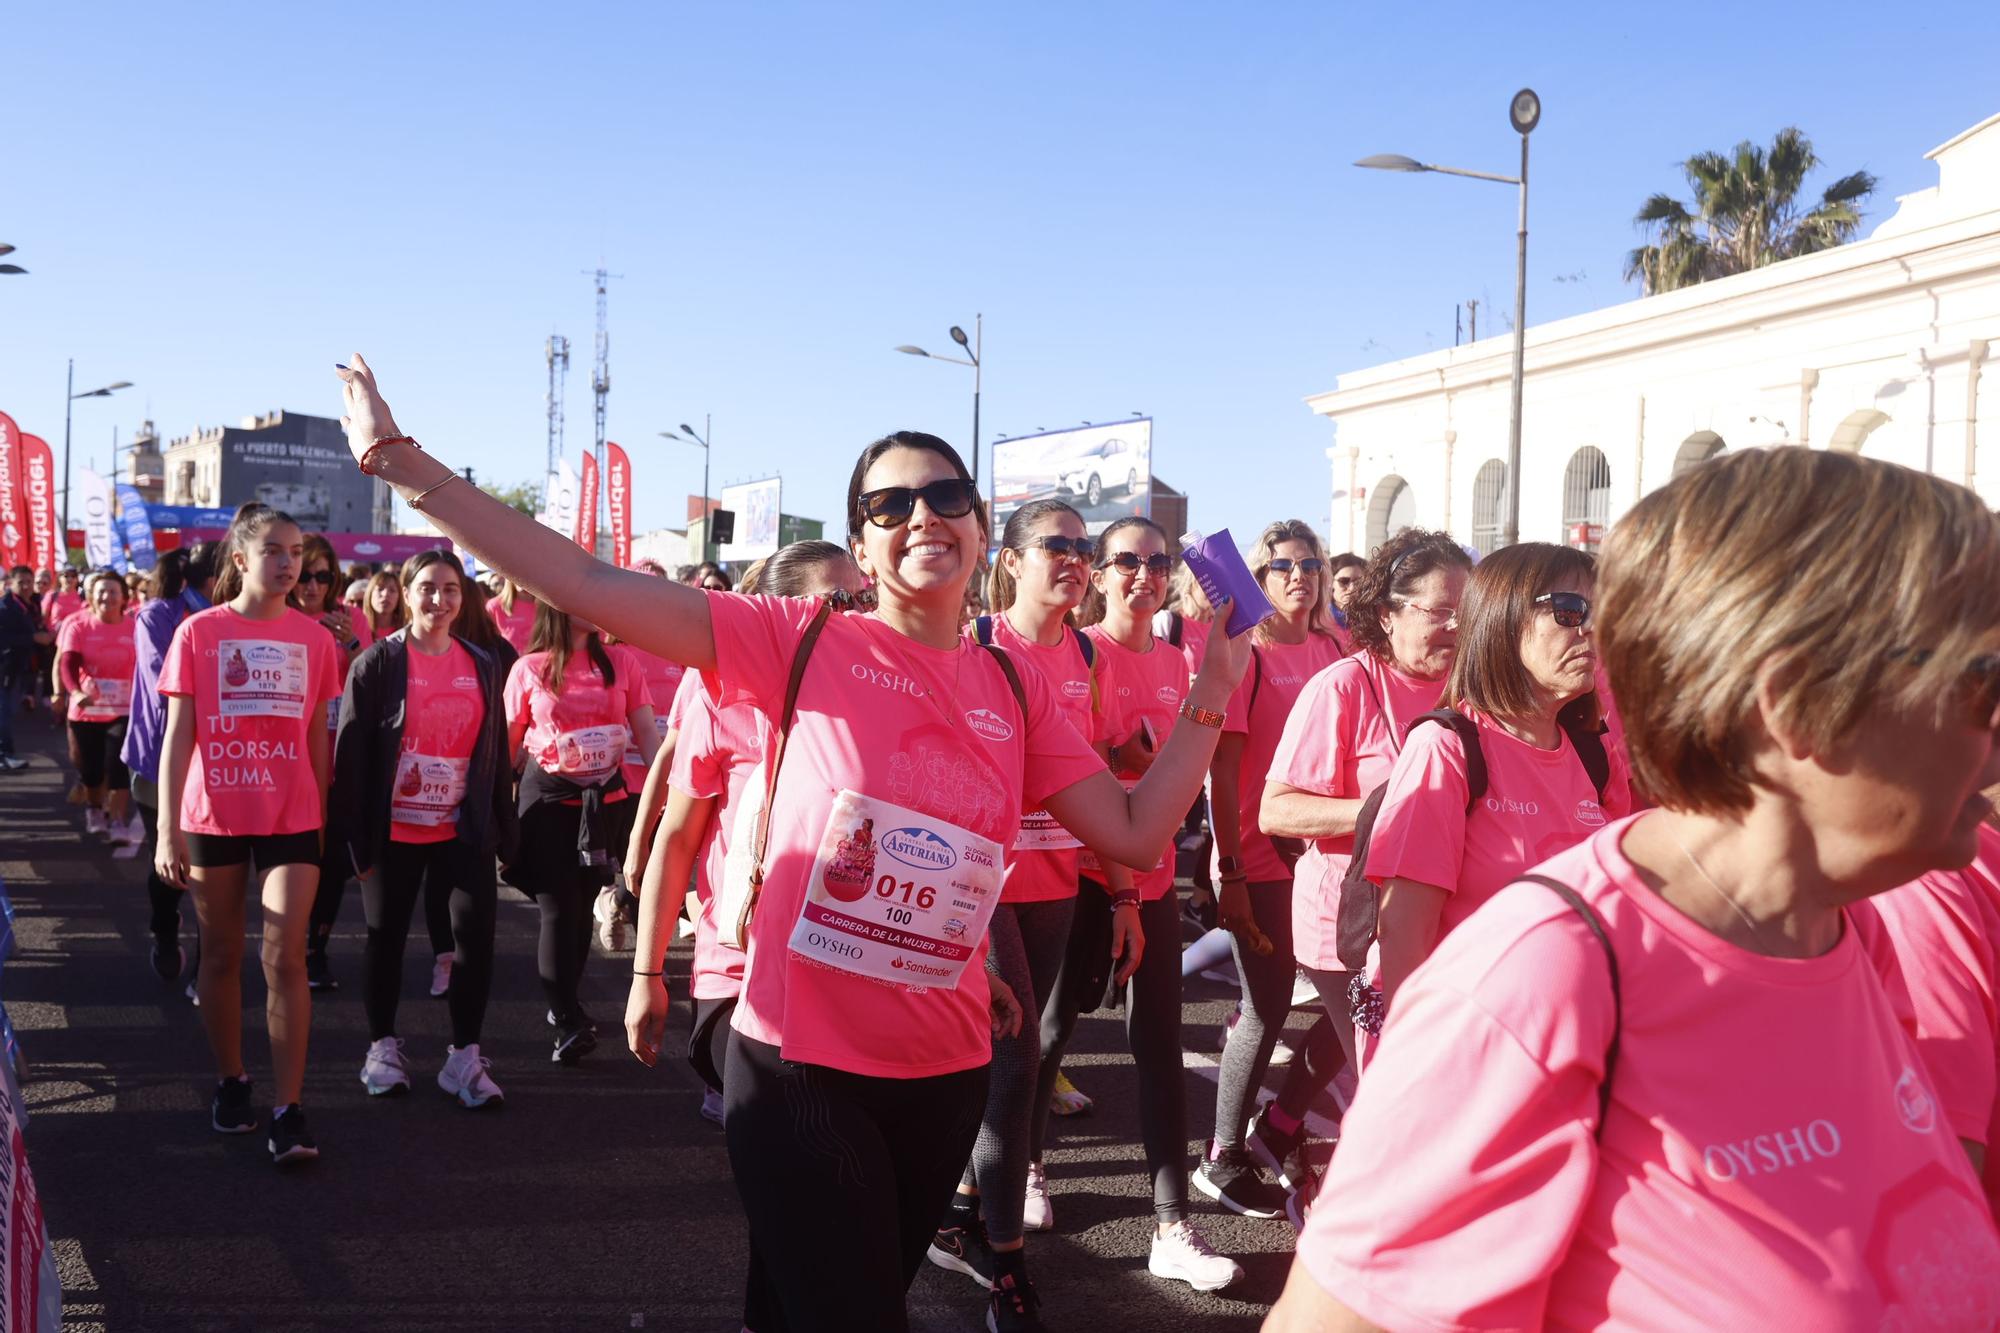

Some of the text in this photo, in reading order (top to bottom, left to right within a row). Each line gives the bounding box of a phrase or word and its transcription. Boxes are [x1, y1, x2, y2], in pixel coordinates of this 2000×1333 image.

[247, 442, 288, 456] PUERTO
[251, 668, 282, 682] 016
[207, 715, 236, 734] TU
[208, 740, 299, 761] DORSAL
[583, 750, 606, 762] 016
[208, 766, 275, 787] SUMA
[423, 783, 449, 794] 016
[1486, 796, 1538, 815] OYSHO
[886, 834, 951, 866] ASTURIANA
[963, 851, 994, 869] SUMA
[876, 874, 938, 910] 016
[885, 906, 913, 926] 100
[820, 912, 960, 958] CARRERA DE LA MUJER 2023
[807, 931, 864, 961] OYSHO
[903, 959, 953, 978] Santander
[904, 982, 929, 995] 2023
[1704, 1117, 1843, 1184] OYSHO
